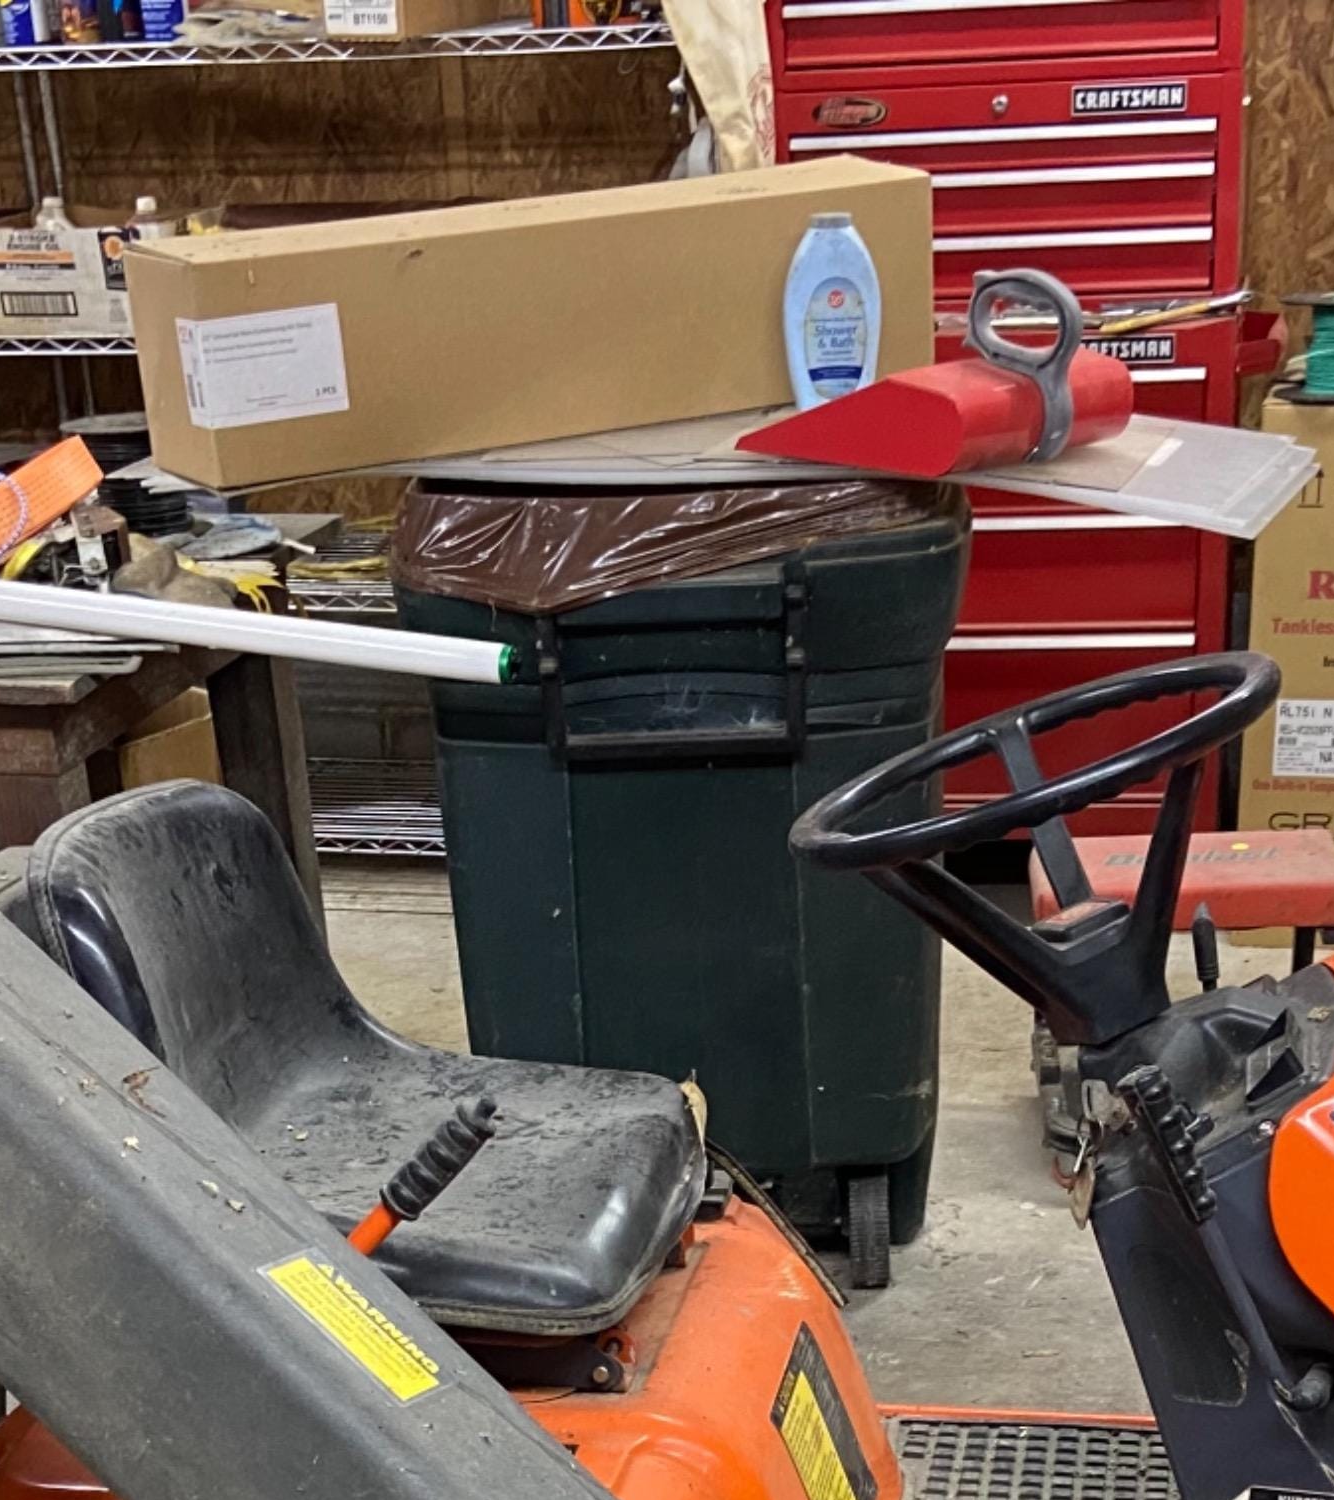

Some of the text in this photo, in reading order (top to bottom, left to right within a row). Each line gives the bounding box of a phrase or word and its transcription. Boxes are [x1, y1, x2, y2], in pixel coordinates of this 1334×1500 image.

[1074, 86, 1183, 111] CRAFTSMAN
[814, 324, 858, 338] Shower
[1323, 707, 1333, 718] N
[335, 1274, 440, 1375] WARNING
